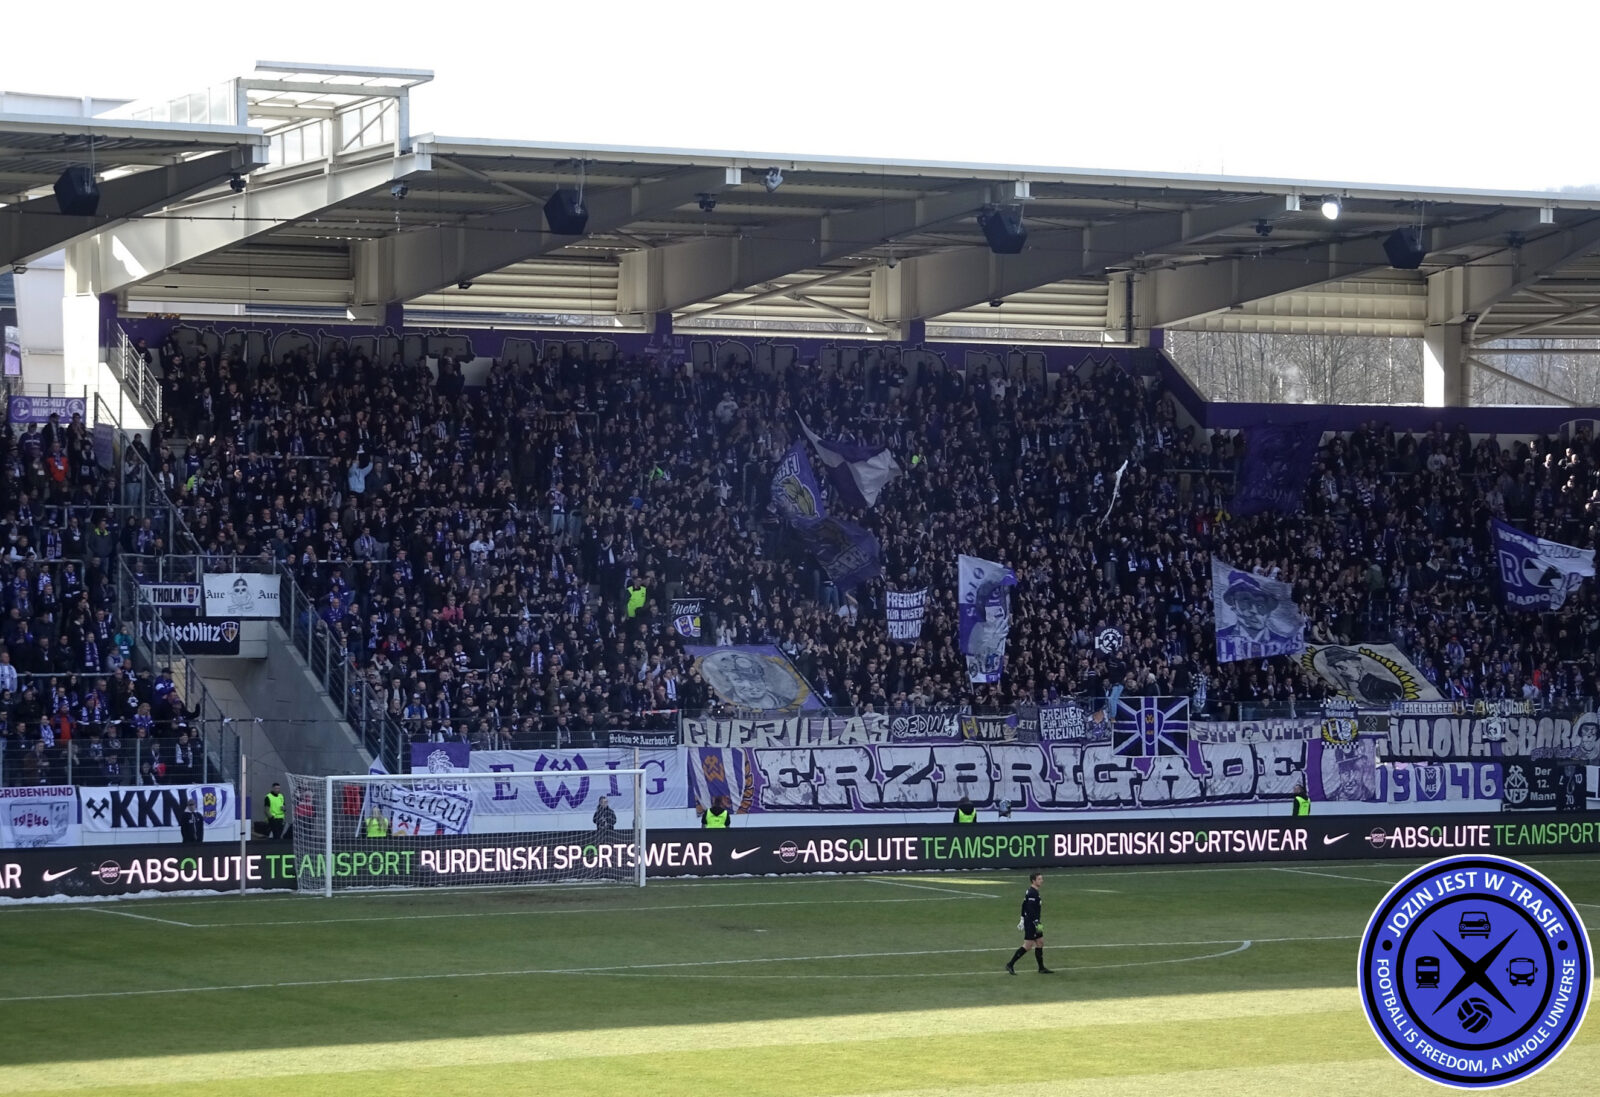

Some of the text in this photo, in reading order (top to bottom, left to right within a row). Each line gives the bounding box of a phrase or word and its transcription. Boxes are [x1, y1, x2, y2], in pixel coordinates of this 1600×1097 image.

[32, 398, 66, 407] WISMUT
[1534, 766, 1552, 776] Der
[1536, 779, 1550, 789] 12.
[1530, 791, 1556, 801] Mann
[110, 789, 189, 829] KKN
[1391, 825, 1491, 849] ABSOLUTE
[803, 829, 1308, 864] ABSOLUTE TEAMSPORT BURDENSKI SPORTSWEAR
[126, 842, 713, 884] ABSOLUTE TEAMSPORT BURDENSKI SPORTSWEAR
